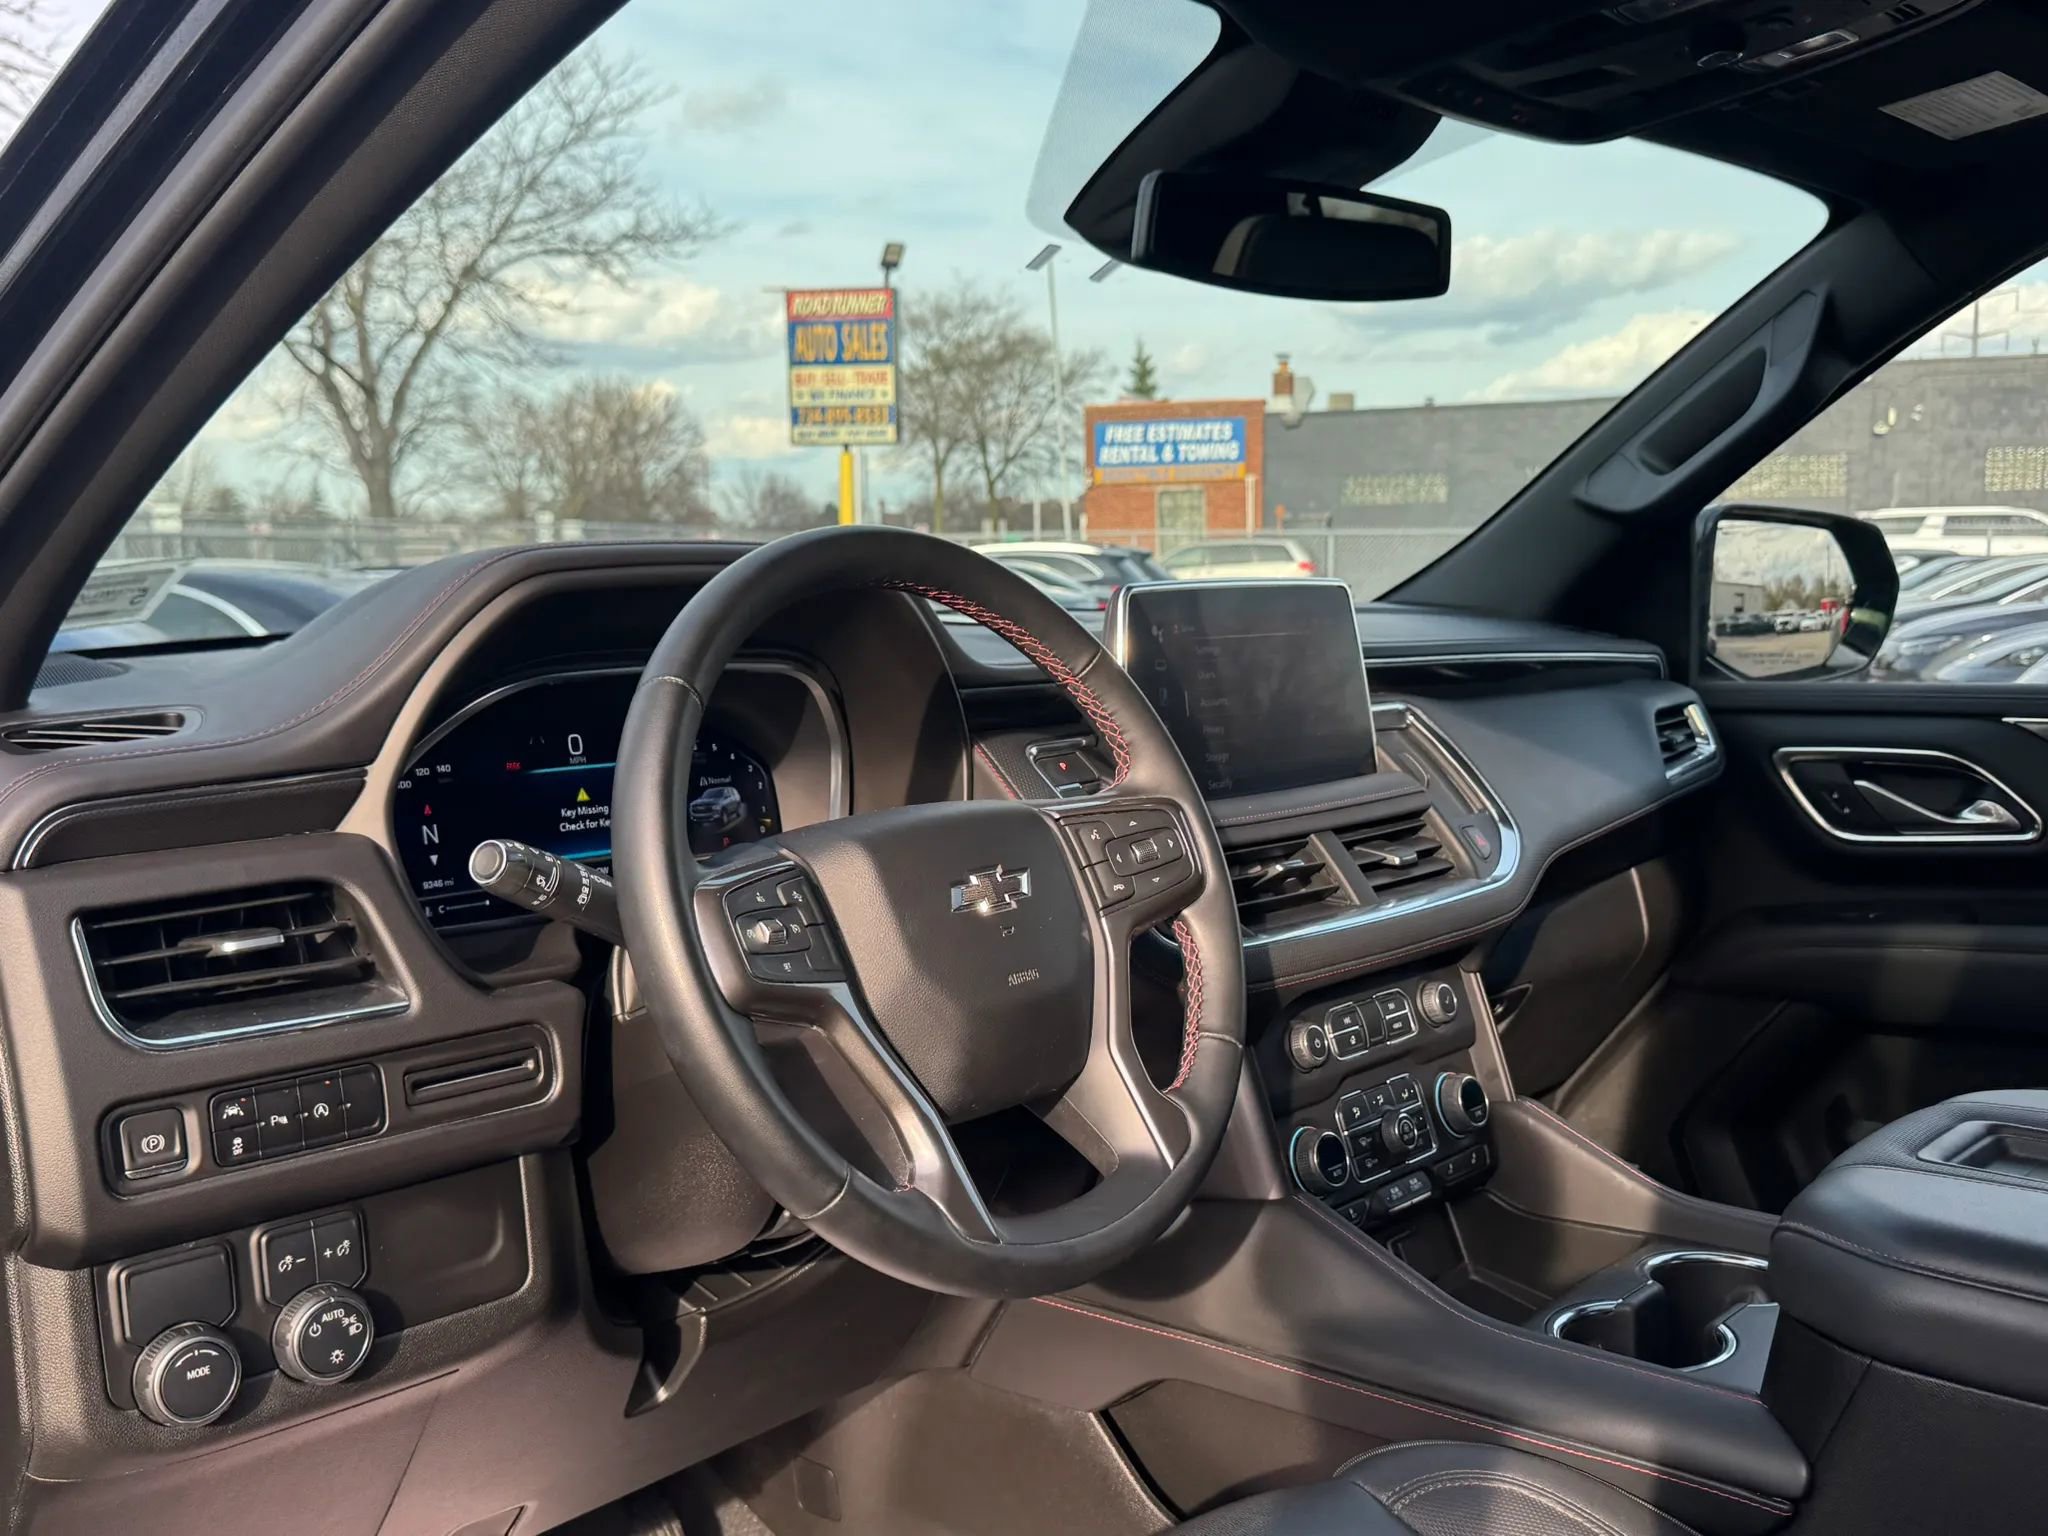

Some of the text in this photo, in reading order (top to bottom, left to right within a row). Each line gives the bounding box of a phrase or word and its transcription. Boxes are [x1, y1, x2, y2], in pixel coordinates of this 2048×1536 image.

[795, 322, 888, 362] AUTO SALES
[1104, 421, 1233, 443] FREE ESTIMATES
[1099, 441, 1240, 464] RENTAL & TOWING
[567, 733, 583, 755] 0
[415, 767, 430, 776] 120
[436, 764, 452, 773] 140
[560, 804, 609, 819] Key Missing
[559, 821, 585, 832] Check
[586, 819, 599, 829] for
[422, 823, 440, 846] N
[321, 1308, 345, 1322] AUTO
[186, 1365, 211, 1380] MODE
